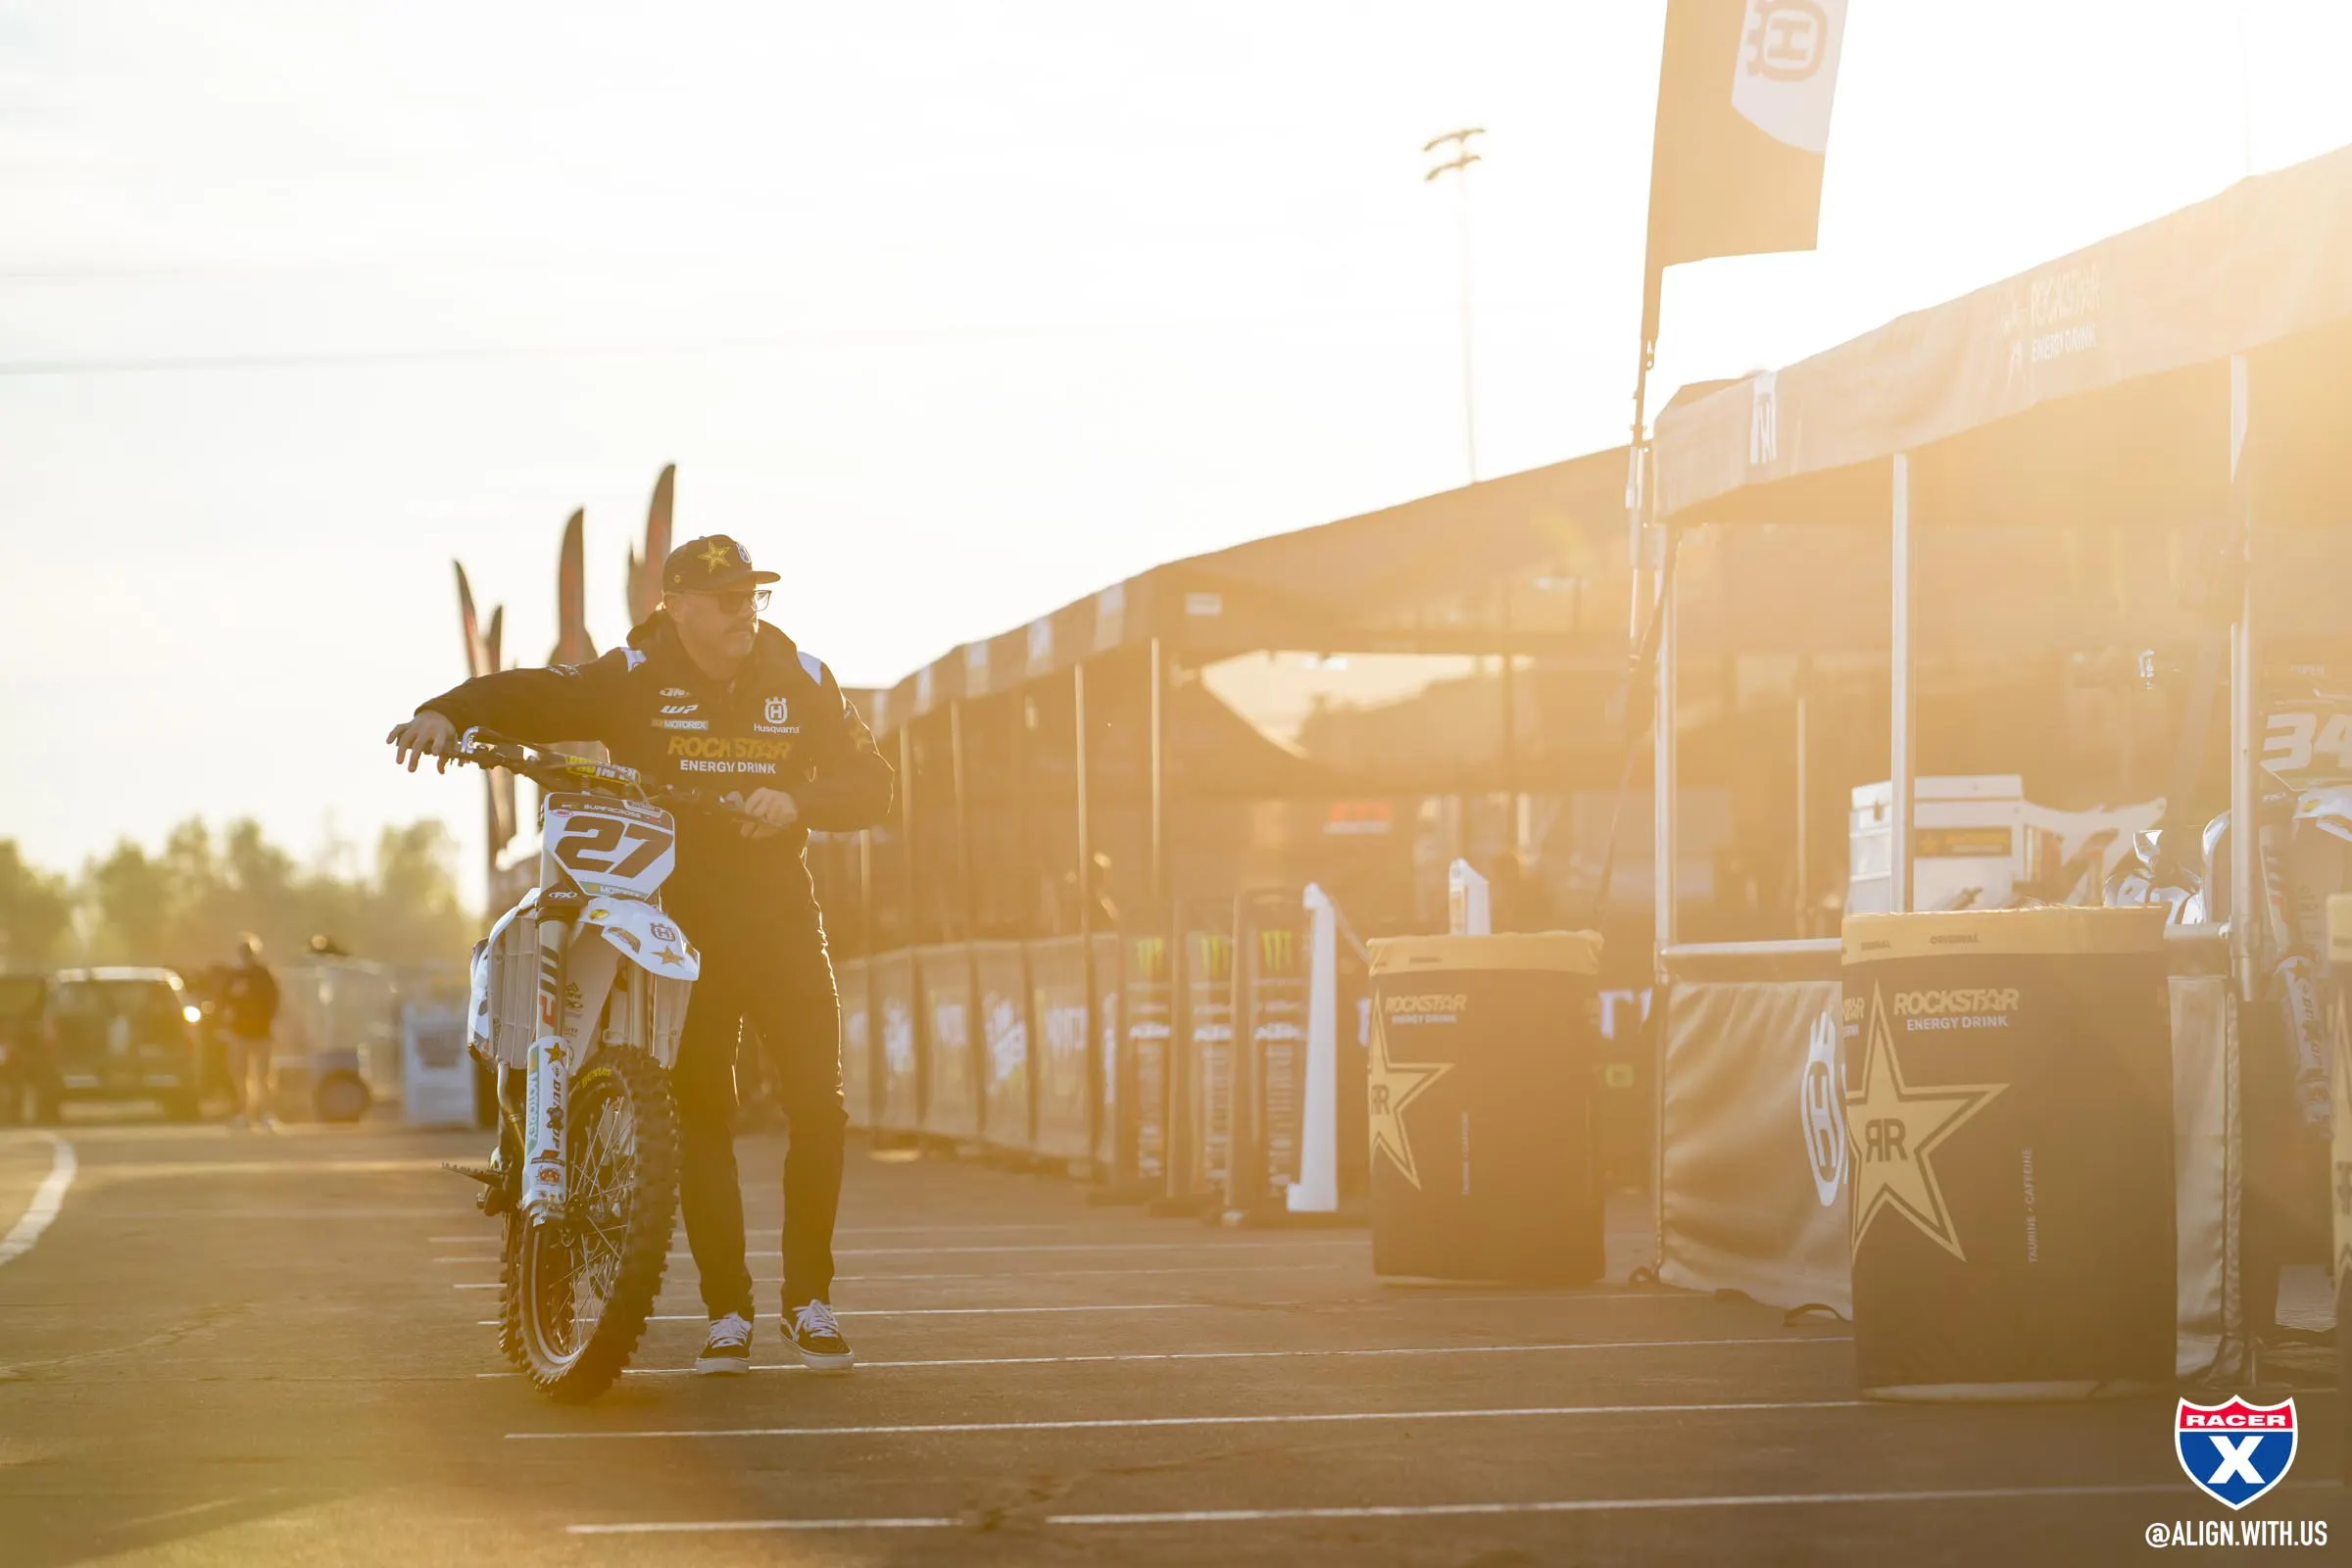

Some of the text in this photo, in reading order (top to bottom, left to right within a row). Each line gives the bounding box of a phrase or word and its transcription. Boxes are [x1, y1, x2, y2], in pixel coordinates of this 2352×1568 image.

[663, 719, 708, 730] MOTOREX
[753, 722, 800, 734] Husqvarna
[680, 760, 777, 774] ENERGY DRINK
[555, 814, 674, 880] 27
[1385, 994, 1468, 1014] ROCKSTAR
[1892, 988, 2020, 1016] ROCKSTAR
[1906, 1015, 2009, 1031] ENERGY DRINK
[581, 1066, 612, 1088] DUNLOP
[2021, 1148, 2035, 1205] CAFFEINE
[2026, 1214, 2039, 1264] TAURINE
